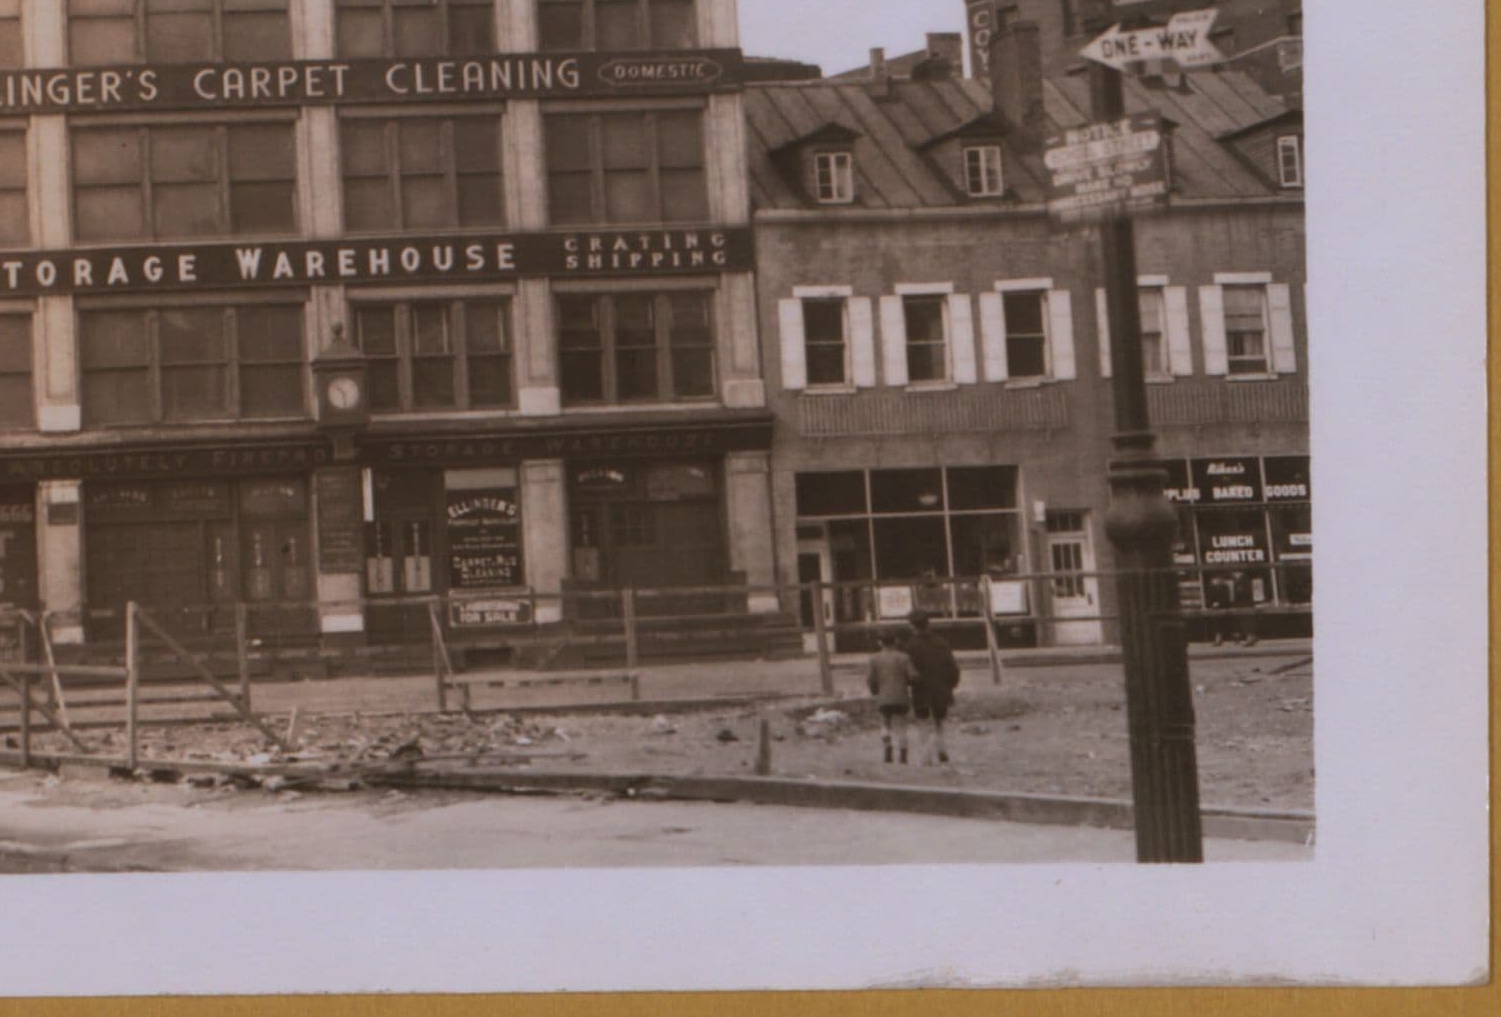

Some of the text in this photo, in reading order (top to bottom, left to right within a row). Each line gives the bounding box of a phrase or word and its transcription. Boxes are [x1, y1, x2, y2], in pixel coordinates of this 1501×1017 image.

[193, 65, 350, 100] CARPET
[386, 58, 580, 93] CLEANING
[613, 61, 707, 81] DOMESTIC
[564, 233, 726, 251] CRATING
[235, 243, 516, 280] WAREHOUSE
[565, 251, 727, 270] SHIPPING
[1212, 485, 1254, 500] BAKED
[1265, 484, 1307, 498] GOODS
[1211, 534, 1255, 549] LUNCH
[1205, 548, 1265, 563] COUNTER
